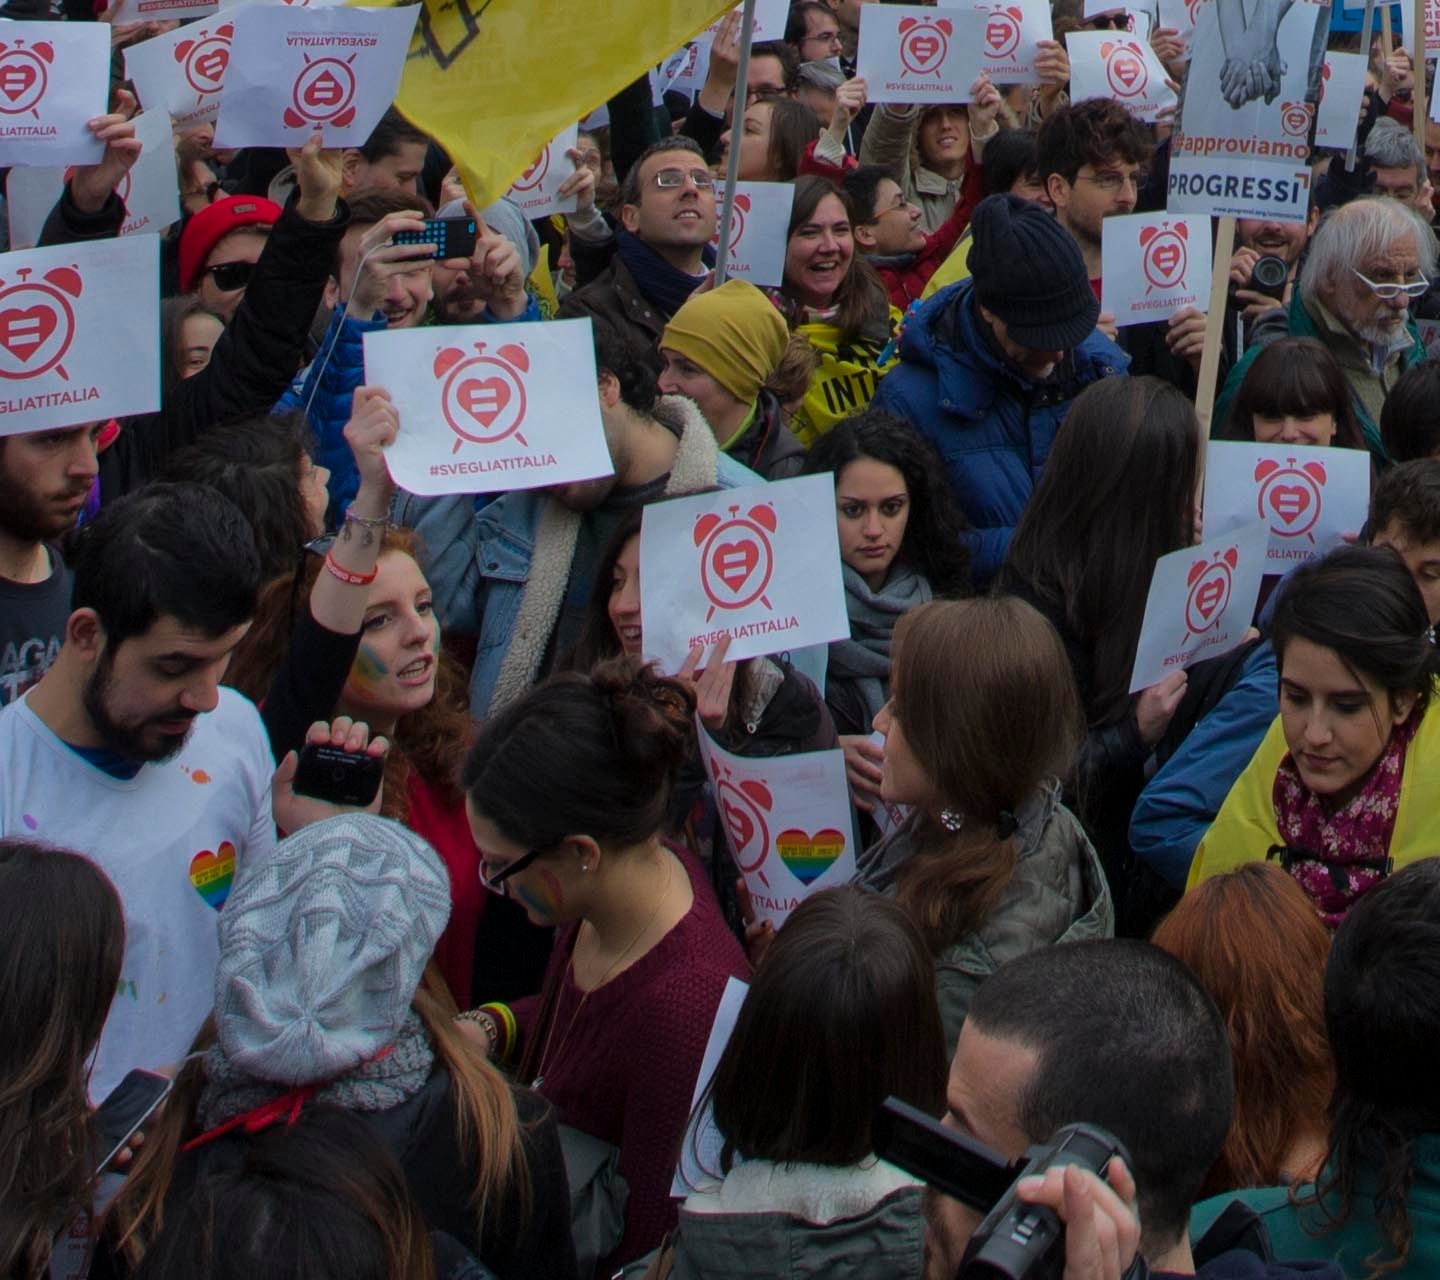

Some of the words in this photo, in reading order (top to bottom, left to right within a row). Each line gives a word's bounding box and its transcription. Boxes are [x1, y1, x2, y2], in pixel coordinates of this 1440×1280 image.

[286, 34, 378, 47] #SVEGLIATITALIA
[1174, 132, 1310, 160] #approviamo
[1168, 173, 1300, 204] PROGRESSI
[429, 453, 558, 477] #SVEGLIATITALIA
[688, 615, 800, 650] #SVEGLIATITALIA
